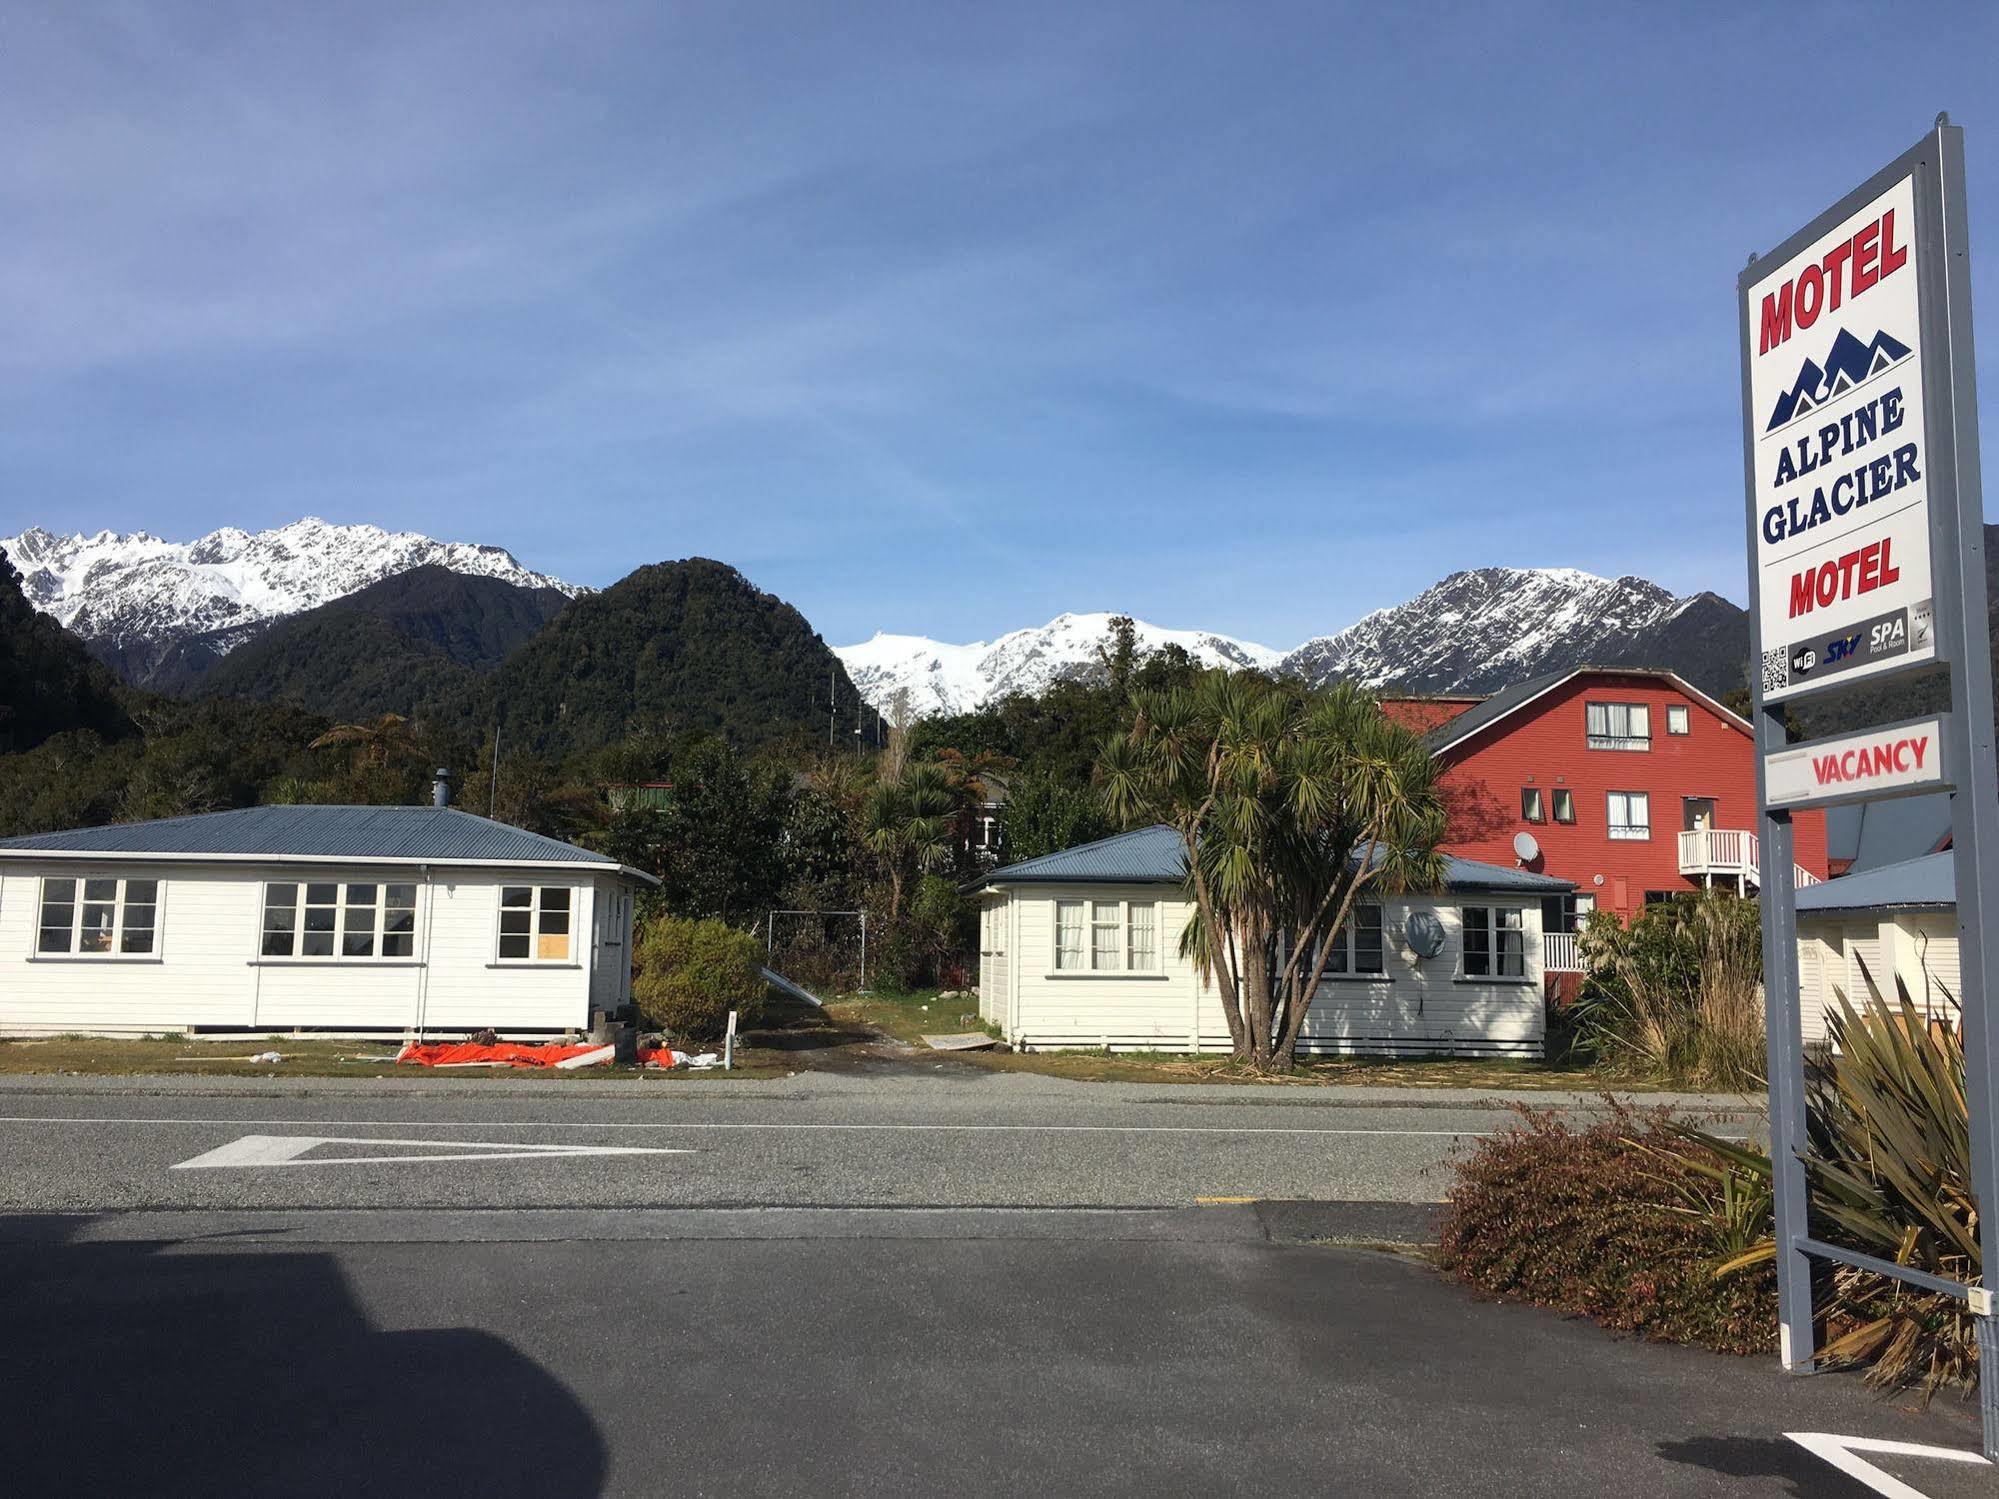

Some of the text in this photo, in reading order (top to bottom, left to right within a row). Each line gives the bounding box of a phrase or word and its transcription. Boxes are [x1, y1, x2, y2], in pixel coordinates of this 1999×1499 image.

[1759, 208, 1907, 357] MOTEL
[1774, 386, 1905, 488] ALPINE
[1763, 443, 1921, 545] GLACIER
[1789, 537, 1900, 619] MOTEL
[1823, 633, 1863, 665] SKY
[1870, 618, 1905, 646] SPA
[1870, 643, 1882, 654] Pool
[1888, 638, 1905, 649] Room
[1813, 736, 1928, 785] VACANCY
